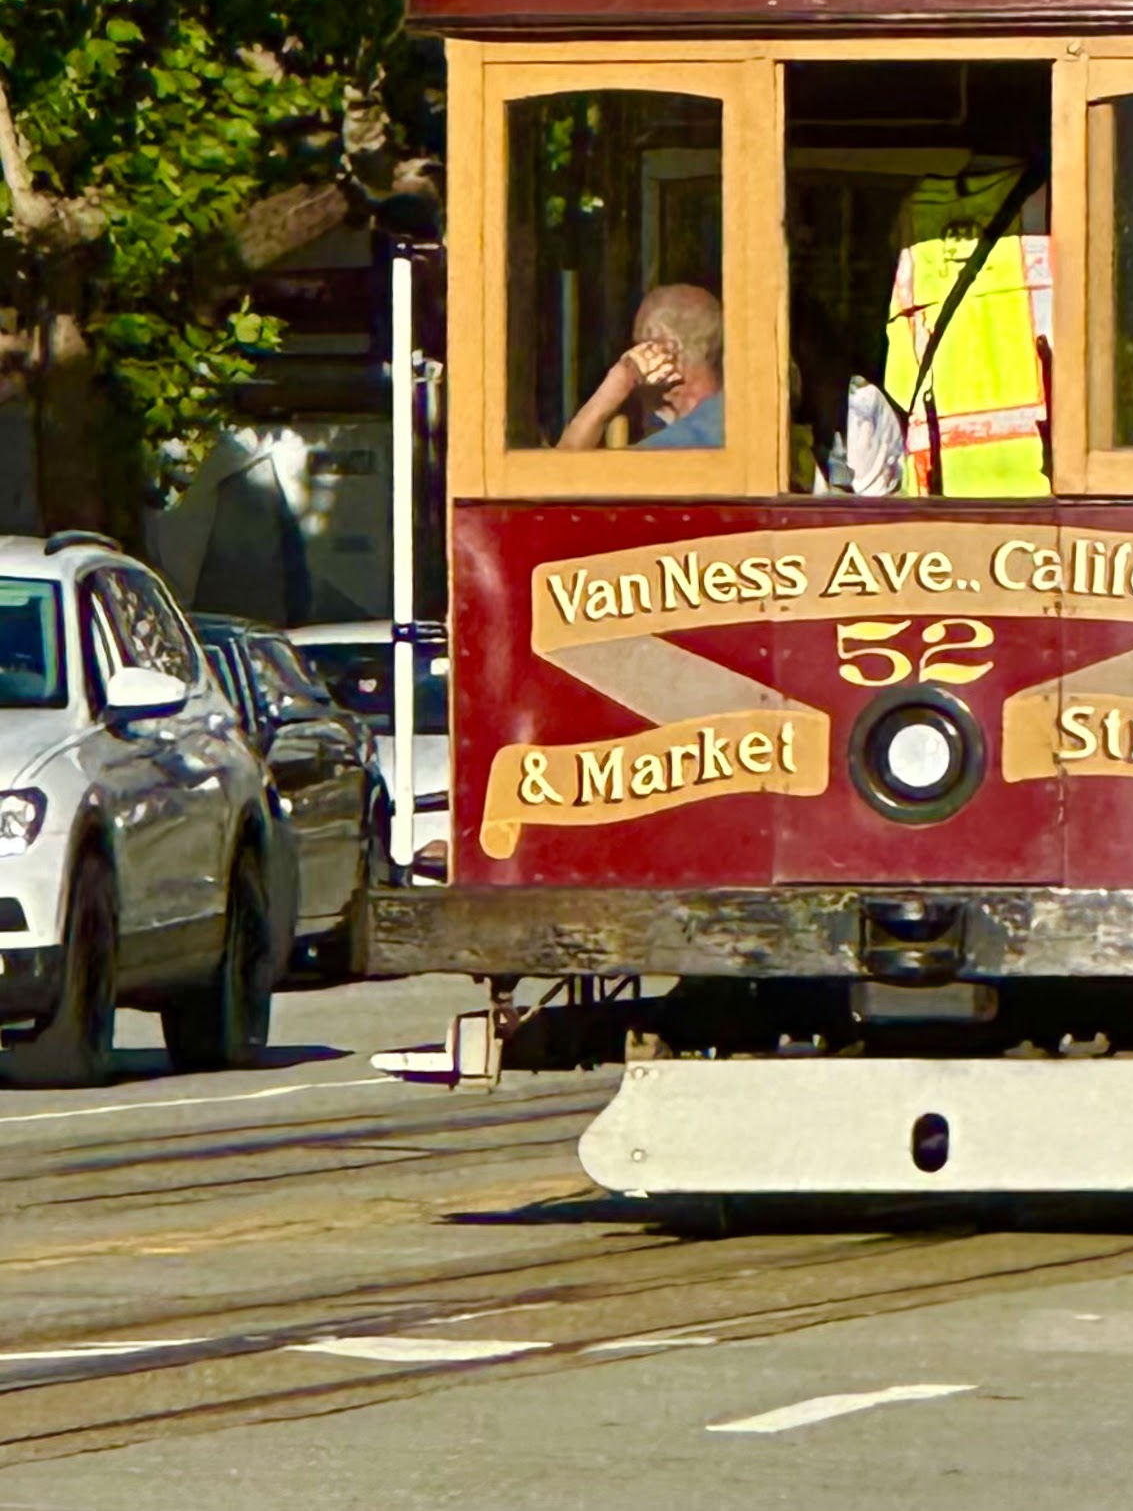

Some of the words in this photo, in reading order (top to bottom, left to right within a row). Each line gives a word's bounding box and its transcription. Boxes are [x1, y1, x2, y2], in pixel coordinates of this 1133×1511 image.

[548, 568, 652, 625] Van
[656, 551, 808, 612] Ness
[836, 617, 994, 687] 52
[517, 750, 564, 806] &
[573, 720, 798, 807] Market
